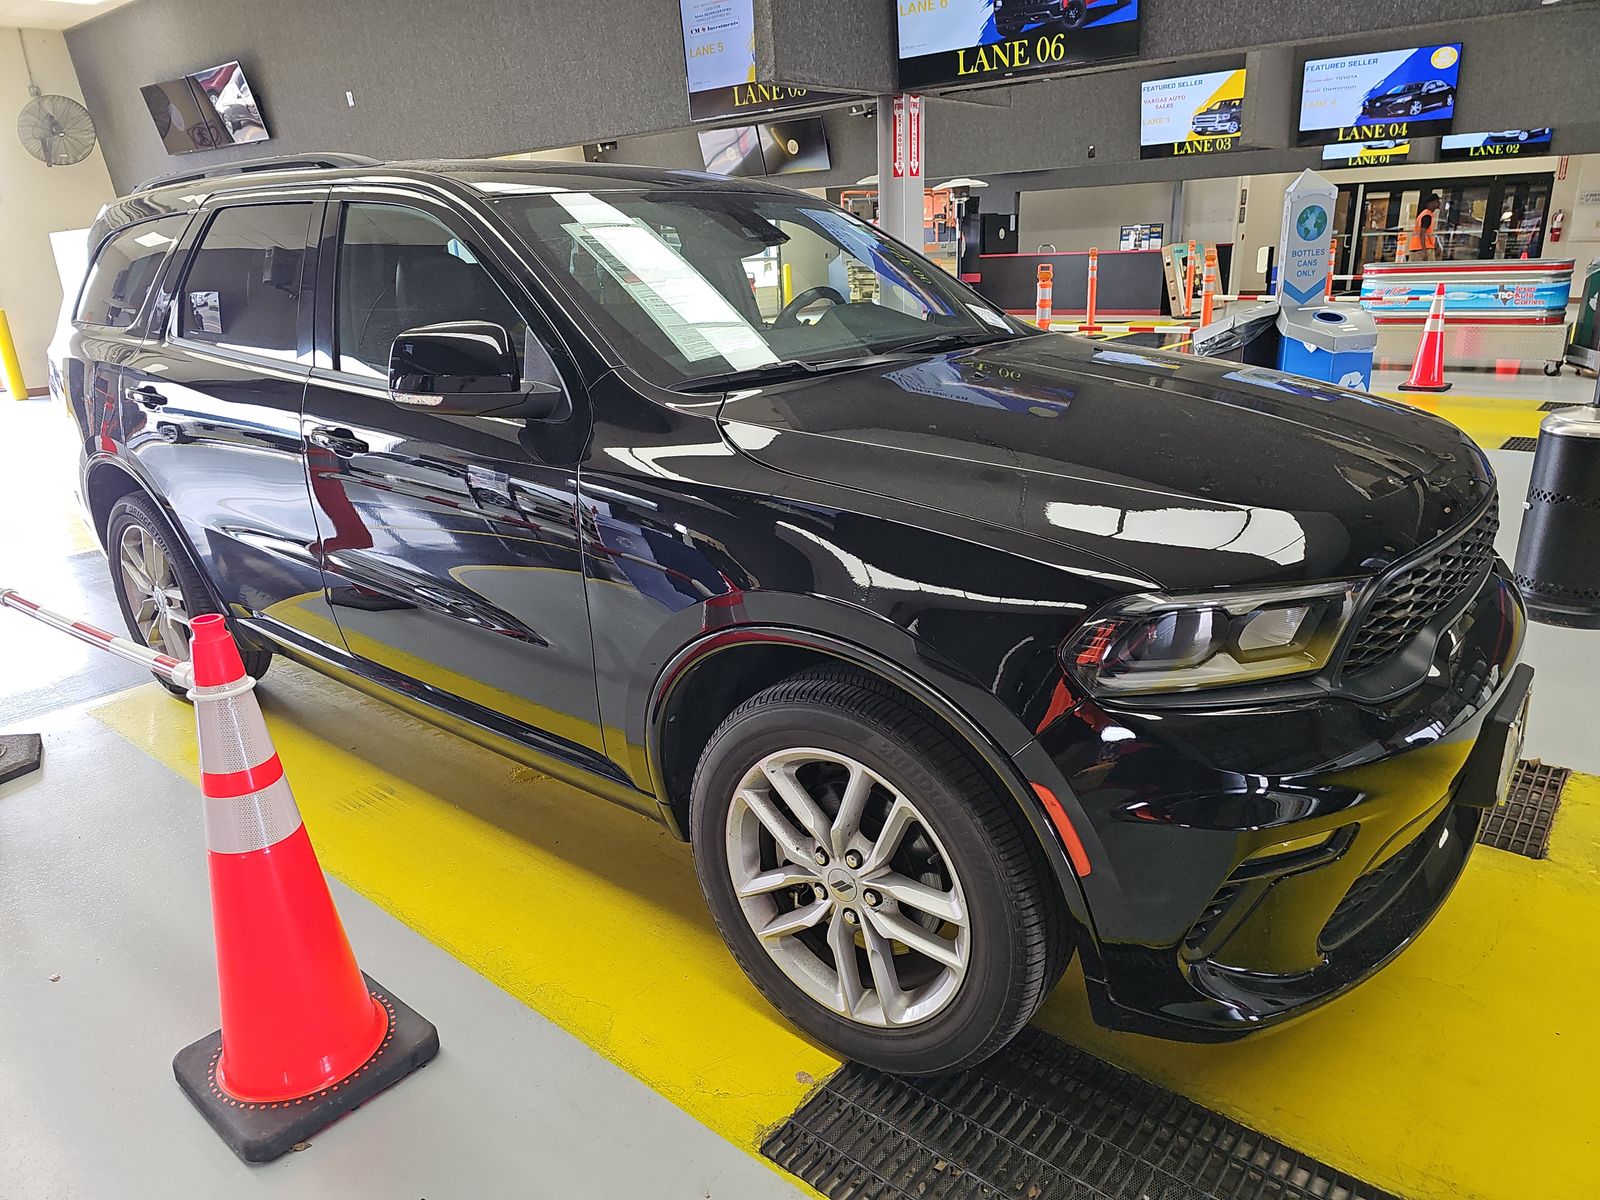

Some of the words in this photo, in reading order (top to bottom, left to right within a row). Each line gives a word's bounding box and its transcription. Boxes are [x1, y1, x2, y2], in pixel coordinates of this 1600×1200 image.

[900, 0, 936, 16] LANE
[690, 43, 715, 58] LANE
[718, 41, 724, 53] 5
[957, 39, 1030, 76] LANE
[1036, 33, 1065, 63] 06
[1305, 62, 1346, 72] FEATURED
[1347, 58, 1379, 68] SELLER
[1143, 83, 1176, 92] FEATURED
[1178, 79, 1203, 88] SELLER
[733, 84, 784, 107] LANE
[1337, 124, 1386, 141] LANE
[1389, 122, 1408, 137] 04
[1173, 139, 1213, 155] LANE
[1215, 138, 1231, 151] 03
[1469, 144, 1504, 157] LANE
[1506, 143, 1520, 154] 02
[1348, 155, 1378, 166] LANE
[1379, 155, 1390, 164] 01
[1291, 248, 1326, 257] BOTTLES
[1297, 259, 1318, 267] CANS
[1296, 269, 1316, 277] ONLY
[1515, 285, 1536, 293] Texas
[128, 505, 171, 559] BRIDGESTONE
